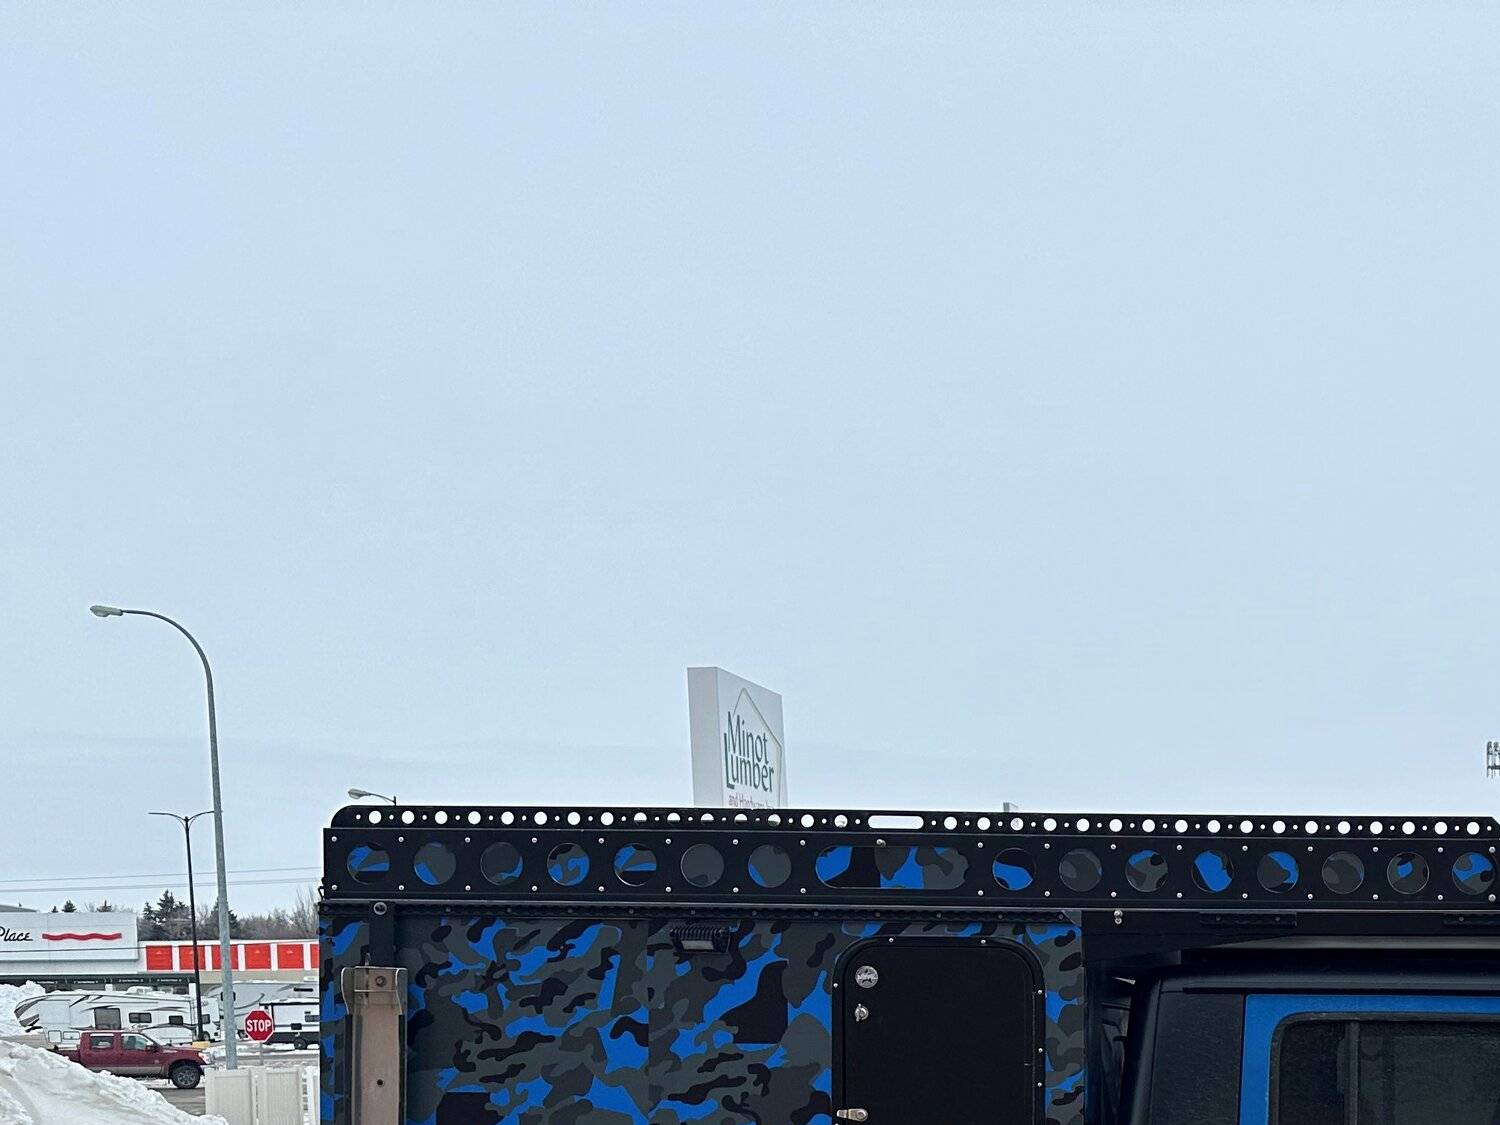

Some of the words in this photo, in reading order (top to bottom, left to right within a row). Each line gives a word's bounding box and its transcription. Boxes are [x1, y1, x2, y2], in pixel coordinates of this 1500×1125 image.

[723, 733, 774, 792] Lumber
[727, 711, 769, 765] Minot
[246, 1019, 271, 1032] STOP
